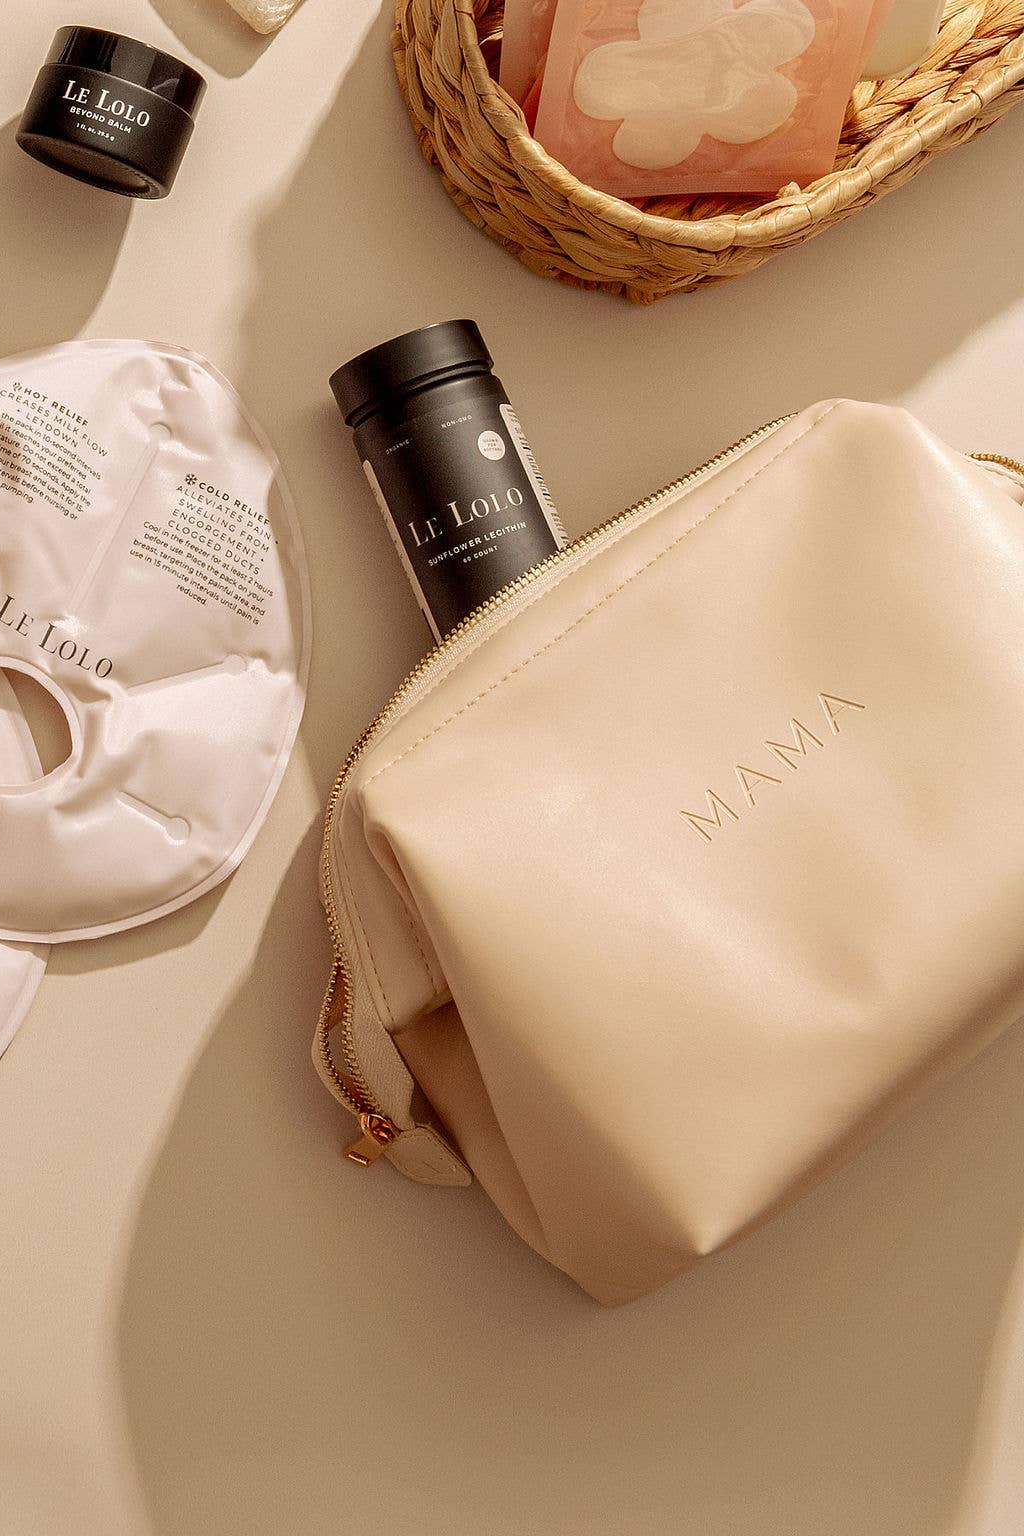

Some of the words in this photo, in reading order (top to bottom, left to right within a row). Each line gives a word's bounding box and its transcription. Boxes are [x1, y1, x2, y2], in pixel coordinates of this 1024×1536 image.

[62, 80, 90, 105] LE
[95, 88, 150, 128] LOLO
[69, 105, 106, 123] BEYOND
[107, 118, 132, 134] BALM
[23, 387, 48, 403] HOT
[51, 400, 89, 426] RELIEF
[25, 412, 79, 448] LETDOWN
[1, 412, 15, 423] the
[14, 419, 33, 433] pack
[71, 457, 101, 481] intervals
[11, 428, 40, 448] reaches
[40, 444, 57, 458] your
[56, 455, 89, 480] preferred
[53, 415, 80, 435] MILK
[81, 433, 108, 457] FLOW
[9, 461, 33, 478] breast
[32, 475, 48, 487] and
[46, 484, 59, 496] use
[65, 495, 75, 507] for
[21, 454, 32, 465] 70
[60, 481, 80, 499] Apply
[79, 495, 91, 507] the
[22, 444, 34, 455] Do
[34, 452, 47, 464] not
[46, 461, 72, 480] exceed
[76, 480, 92, 494] total
[20, 479, 44, 497] before
[43, 494, 70, 517] nursing
[69, 513, 78, 521] or
[175, 485, 244, 523] ALLEVIATES
[246, 520, 271, 540] PAIN
[178, 498, 236, 533] SWELLING
[239, 529, 270, 553] FROM
[198, 482, 230, 501] COLD
[233, 499, 270, 525] RELIEF
[407, 516, 443, 547] LE
[447, 486, 524, 527] LOLO
[143, 521, 162, 533] Cool
[161, 528, 170, 537] in
[170, 533, 184, 545] the
[184, 539, 210, 558] freezer
[210, 554, 222, 565] for
[221, 562, 230, 571] at
[230, 566, 248, 581] least
[247, 576, 254, 585] 2
[253, 580, 274, 597] hours
[167, 519, 222, 552] CLOGGED
[224, 549, 260, 575] DUCTS
[172, 508, 257, 558] ENGORGEMENT
[428, 536, 482, 567] SUNFLOWER
[483, 521, 527, 541] LECITHIN
[473, 545, 498, 559] COUNT
[129, 549, 144, 560] use
[144, 555, 152, 563] in
[153, 558, 162, 568] 15
[161, 564, 190, 583] minute
[189, 577, 219, 601] intervals
[220, 598, 238, 611] until
[236, 608, 253, 621] pain
[252, 616, 260, 625] is
[143, 532, 169, 548] before
[185, 552, 206, 568] Place
[206, 564, 220, 576] the
[219, 573, 237, 587] pack
[237, 584, 248, 593] on
[246, 590, 265, 603] your
[159, 551, 195, 575] targeting
[195, 569, 208, 582] the
[207, 578, 234, 597] painful
[250, 604, 266, 616] and
[38, 623, 114, 679] LOLO
[679, 693, 866, 843] MAMA
